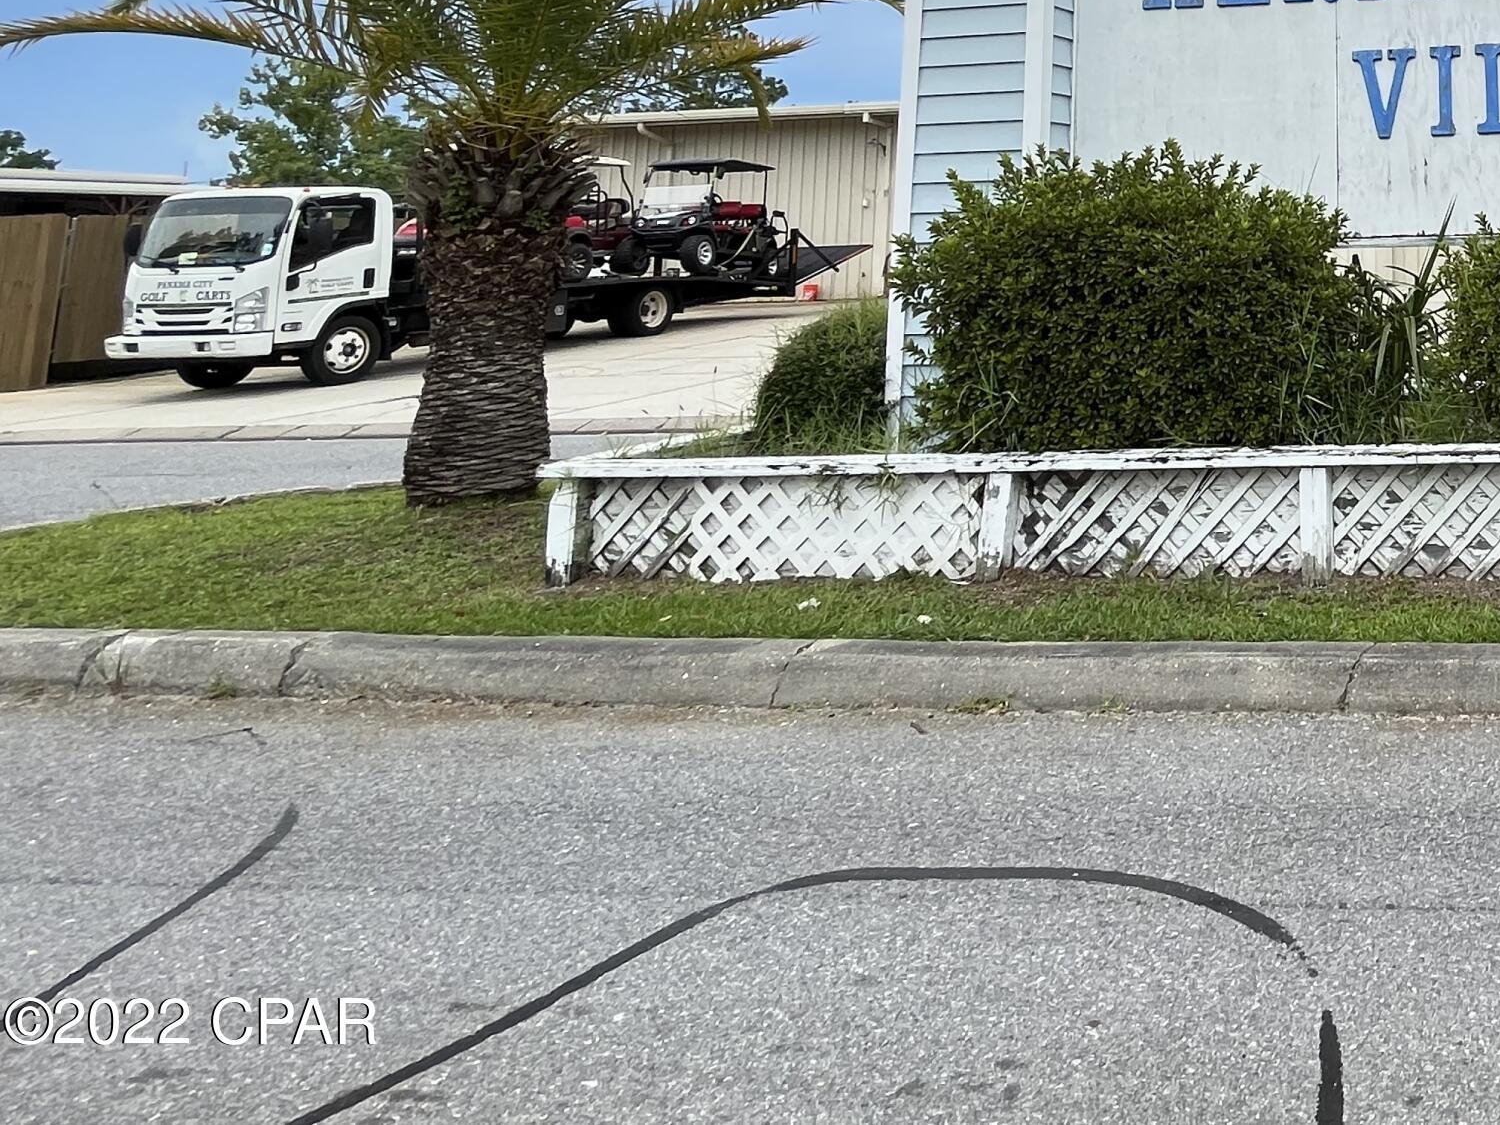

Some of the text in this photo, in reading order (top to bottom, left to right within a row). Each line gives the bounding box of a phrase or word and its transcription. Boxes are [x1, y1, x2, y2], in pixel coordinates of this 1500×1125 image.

[192, 280, 214, 288] CITY
[140, 290, 231, 302] GOLF CARTS
